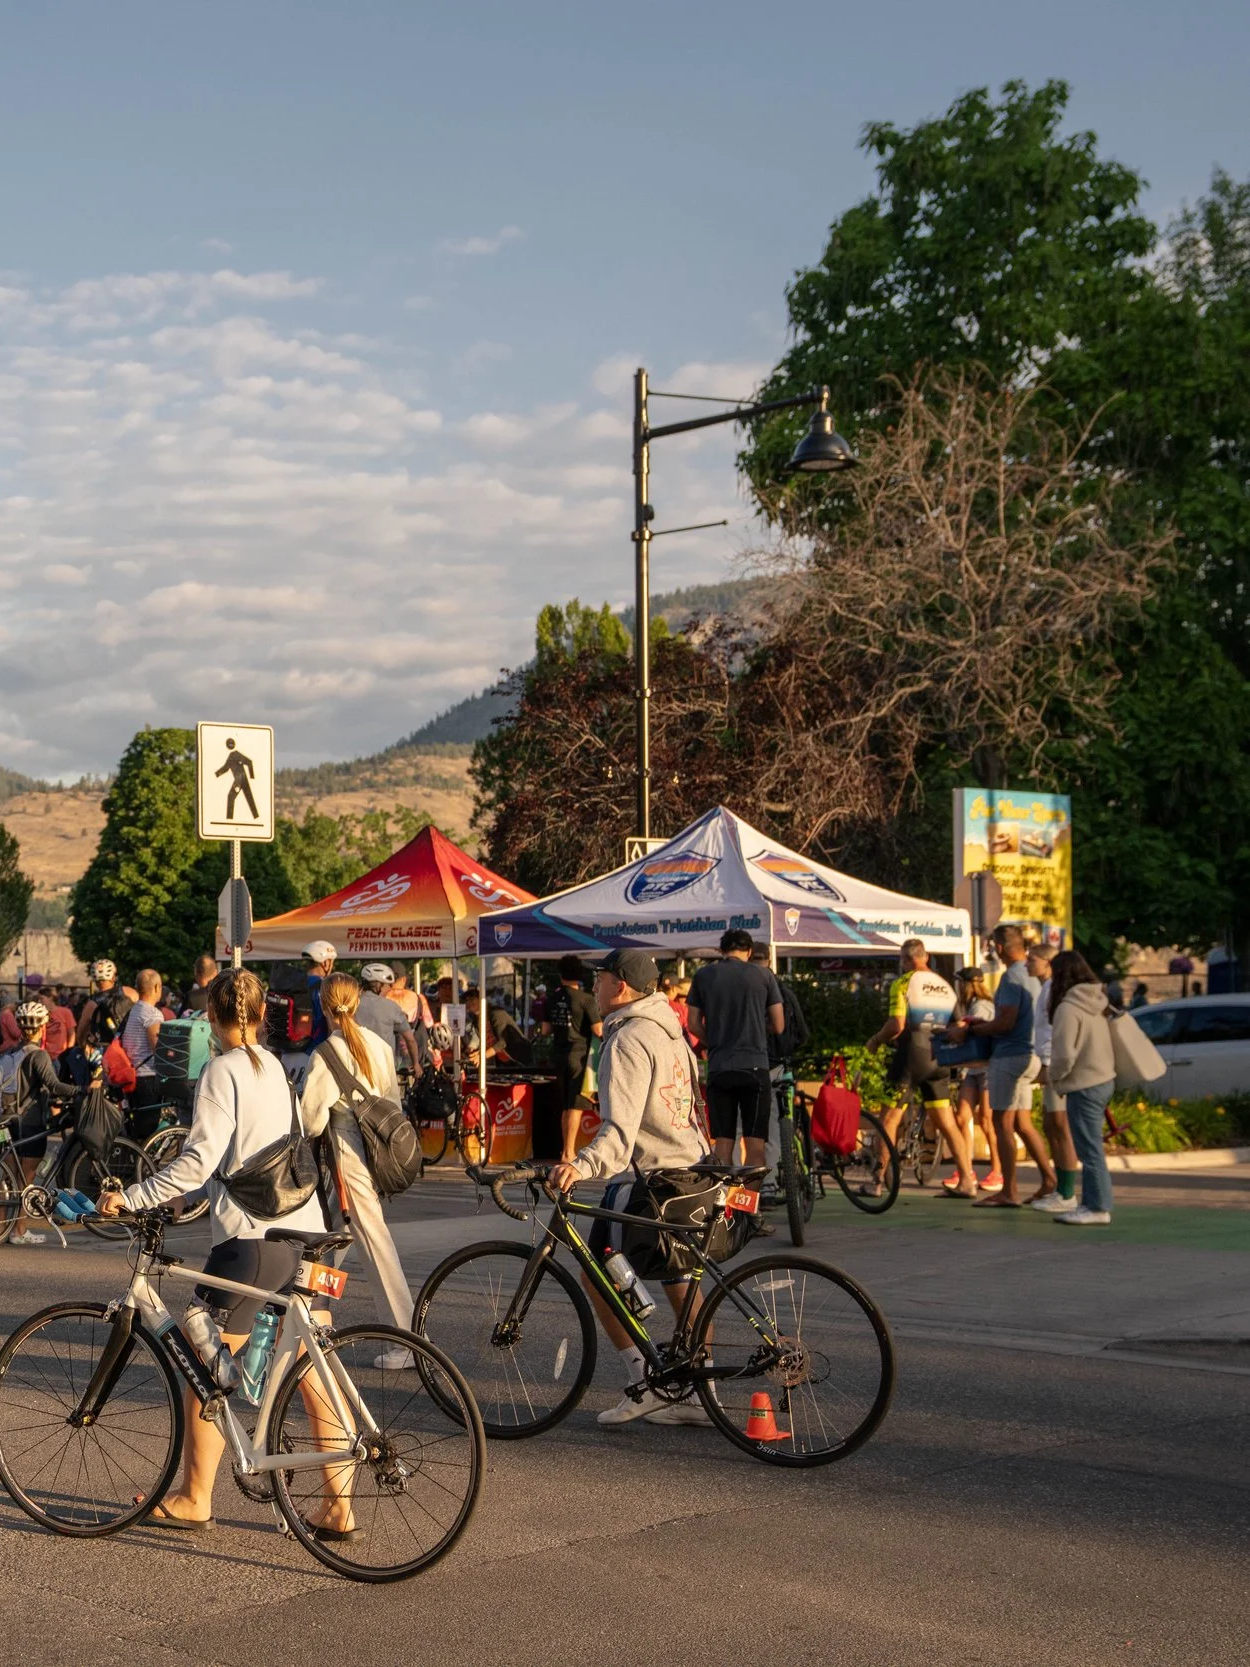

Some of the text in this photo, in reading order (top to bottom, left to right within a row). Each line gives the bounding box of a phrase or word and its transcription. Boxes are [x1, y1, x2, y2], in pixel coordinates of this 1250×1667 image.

[346, 925, 443, 939] PEACH CLASSIC
[349, 941, 393, 953] PENTICTON
[395, 940, 442, 951] TRIATHLON
[734, 1192, 752, 1207] 137
[317, 1271, 340, 1290] 401
